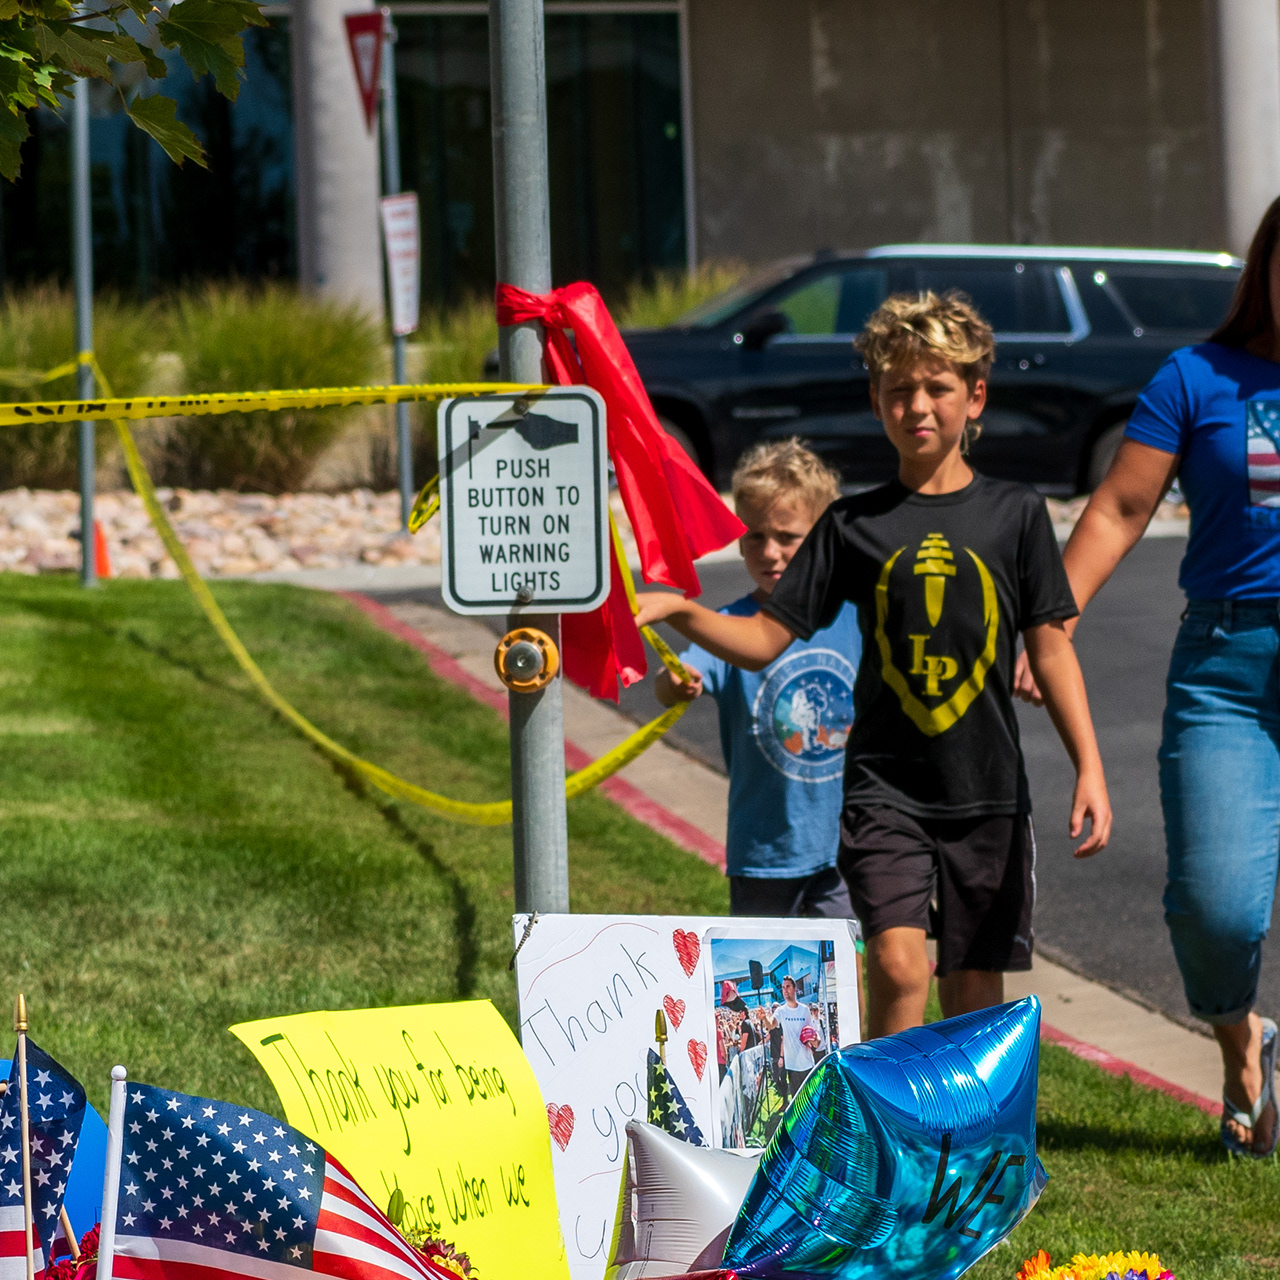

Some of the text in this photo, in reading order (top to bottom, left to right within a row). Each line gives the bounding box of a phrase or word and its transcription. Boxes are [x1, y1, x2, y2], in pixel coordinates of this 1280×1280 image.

[496, 458, 551, 479] PUSH
[468, 485, 580, 508] BUTTON TO
[478, 514, 570, 536] TURN ON
[479, 542, 571, 564] WARNING
[492, 571, 561, 592] LIGHTS
[908, 634, 958, 696] LP
[520, 943, 659, 1067] Thank
[260, 1029, 518, 1156] Thank you for being
[922, 1133, 1026, 1240] WE
